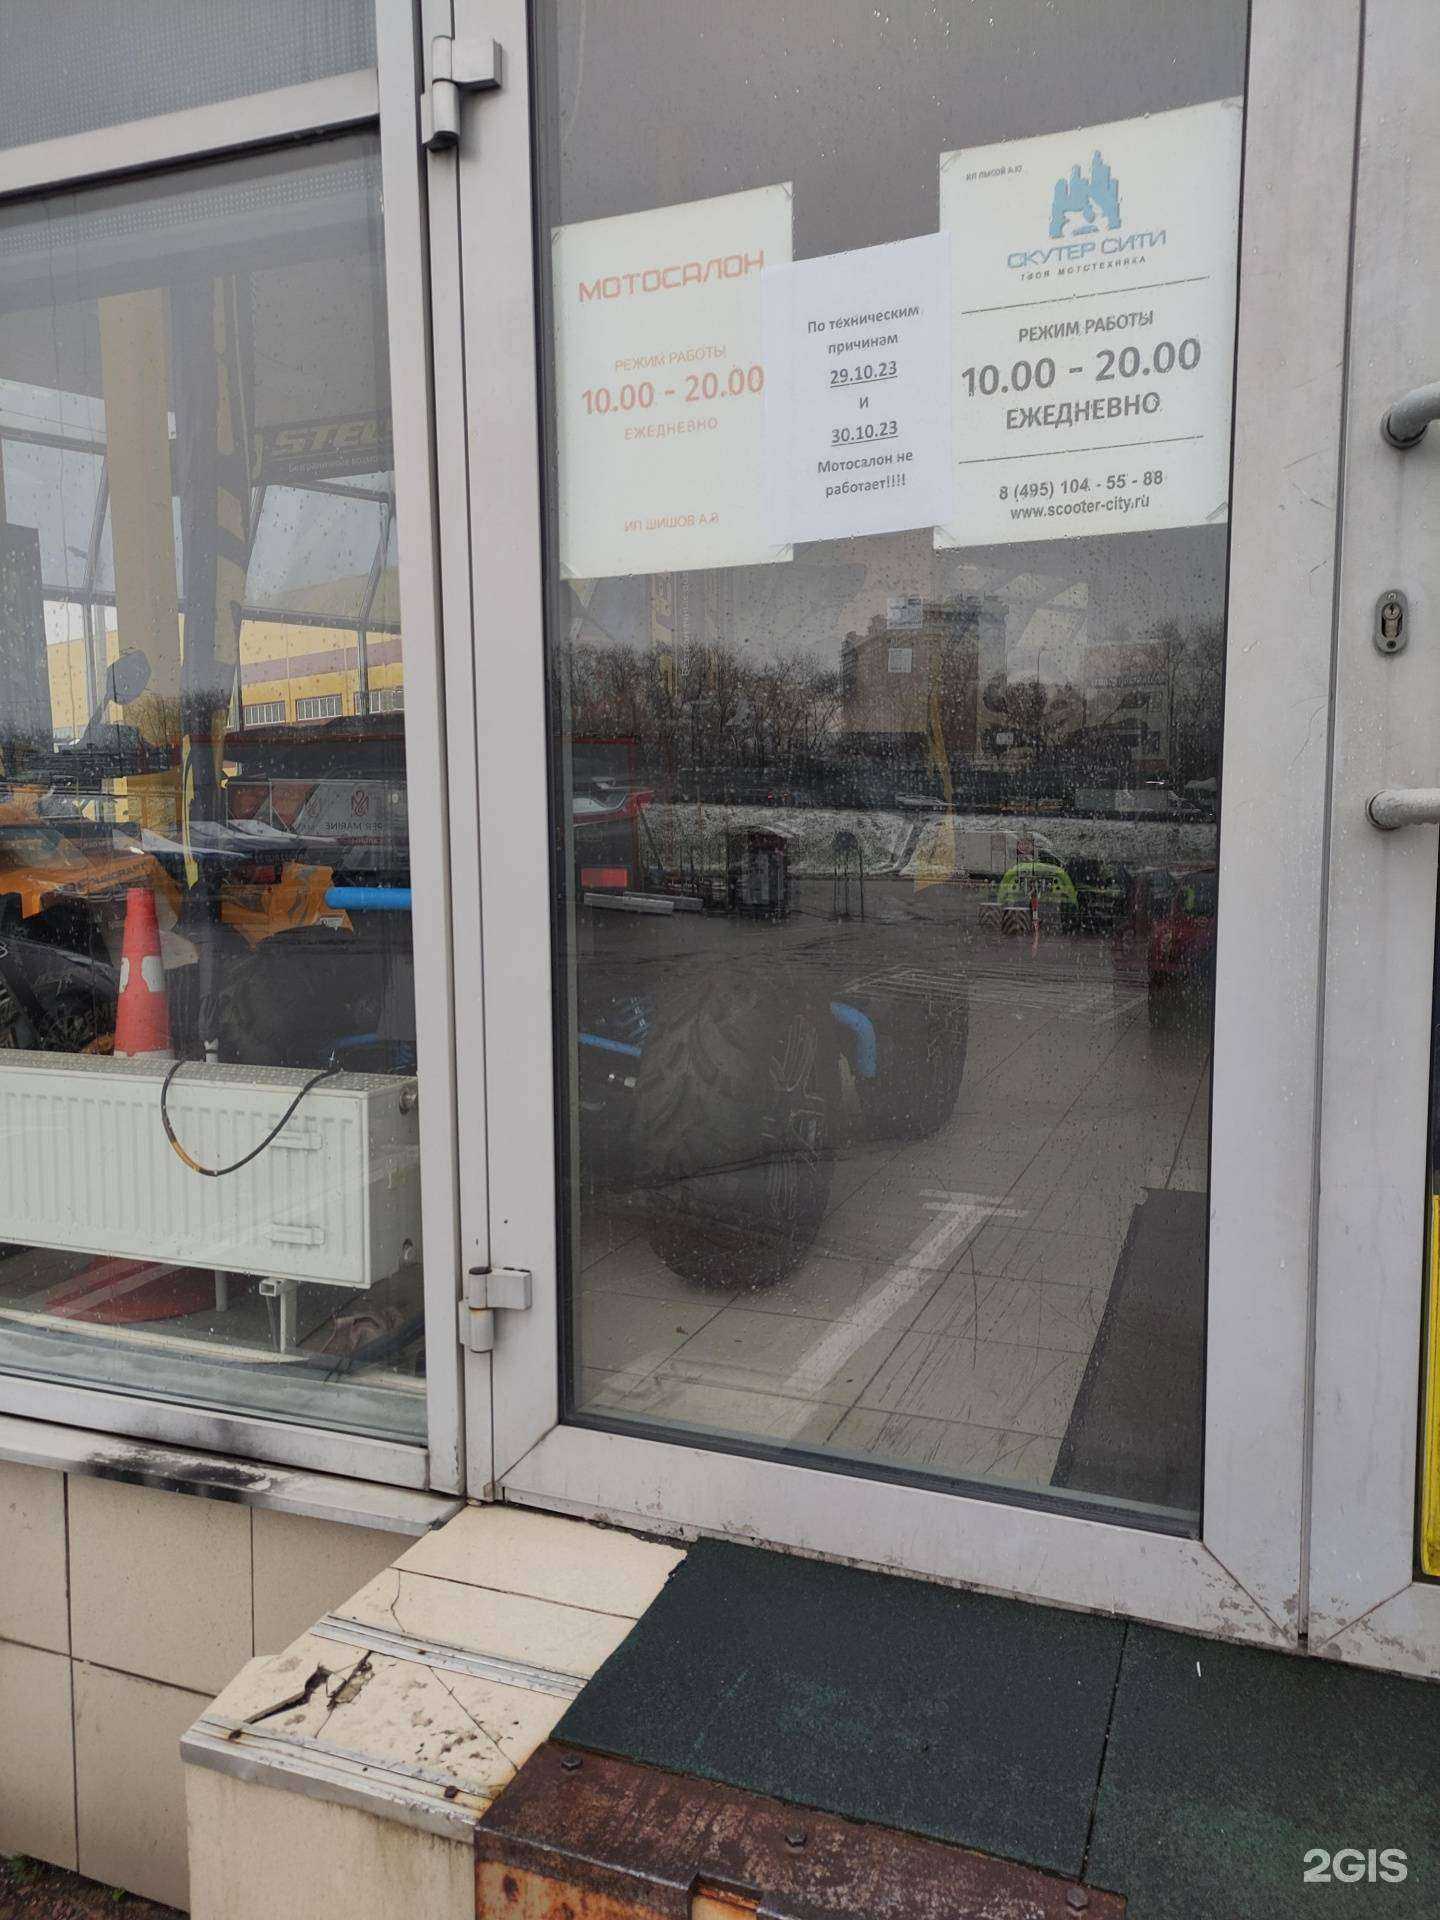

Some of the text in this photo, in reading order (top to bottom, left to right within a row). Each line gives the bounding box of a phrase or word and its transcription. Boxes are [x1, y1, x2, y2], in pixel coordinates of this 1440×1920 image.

[1007, 230, 1167, 269] СКУТЕР СИТИ
[578, 249, 764, 303] МОТОСАЛОН
[807, 305, 920, 334] По техническим
[1018, 310, 1153, 343] РЕЖИМ РАБОТЫ
[615, 345, 727, 372] РЕЖИМ РАБОТЫ
[828, 334, 898, 355] причинам
[829, 360, 898, 388] 29.10.23
[961, 357, 1056, 397] 10.00
[1095, 337, 1202, 382] 20.00
[581, 381, 655, 415] 10.00
[685, 365, 765, 402] 20.00
[1005, 391, 1161, 430] ЕЖЕДНЕВНО
[624, 416, 719, 441] ЕЖЕДНЕВНО
[831, 420, 899, 447] 30.10.23
[817, 451, 914, 474] Мотосалон не
[999, 486, 1009, 500] 8
[1013, 480, 1055, 502] (495)
[1107, 473, 1127, 490] 55
[1143, 470, 1164, 486] 88
[1010, 495, 1150, 520] www.scooter-city.ru
